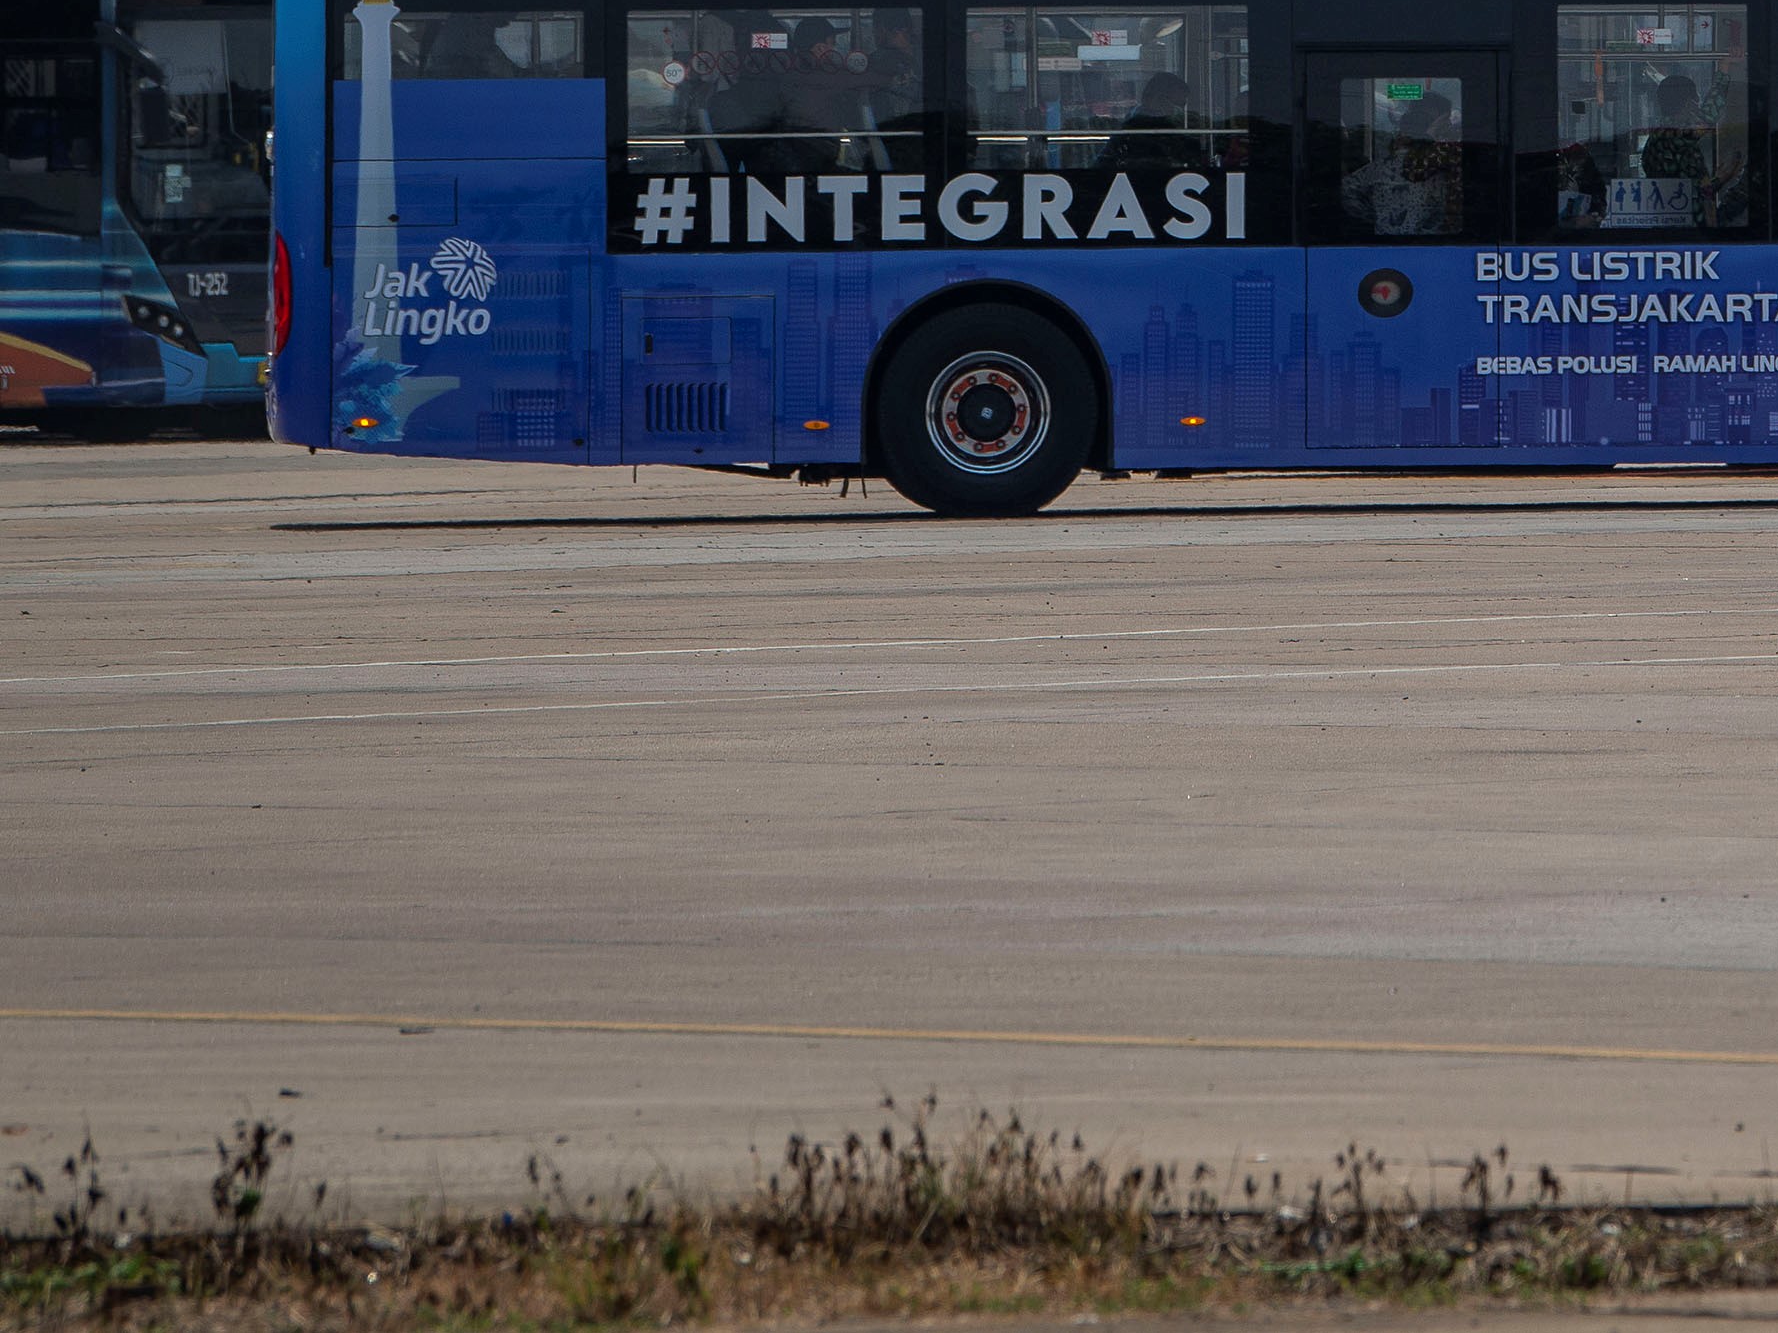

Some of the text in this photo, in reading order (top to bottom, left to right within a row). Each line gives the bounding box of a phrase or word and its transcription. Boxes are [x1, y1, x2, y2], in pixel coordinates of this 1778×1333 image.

[634, 172, 1247, 244] #INTEGRASI
[364, 262, 433, 299] Jak
[1477, 251, 1720, 281] BUS LISTRIK
[364, 300, 491, 346] Lingko
[1477, 355, 1637, 374] BEBAS POLUSI
[1653, 355, 1736, 373] RAMAH
